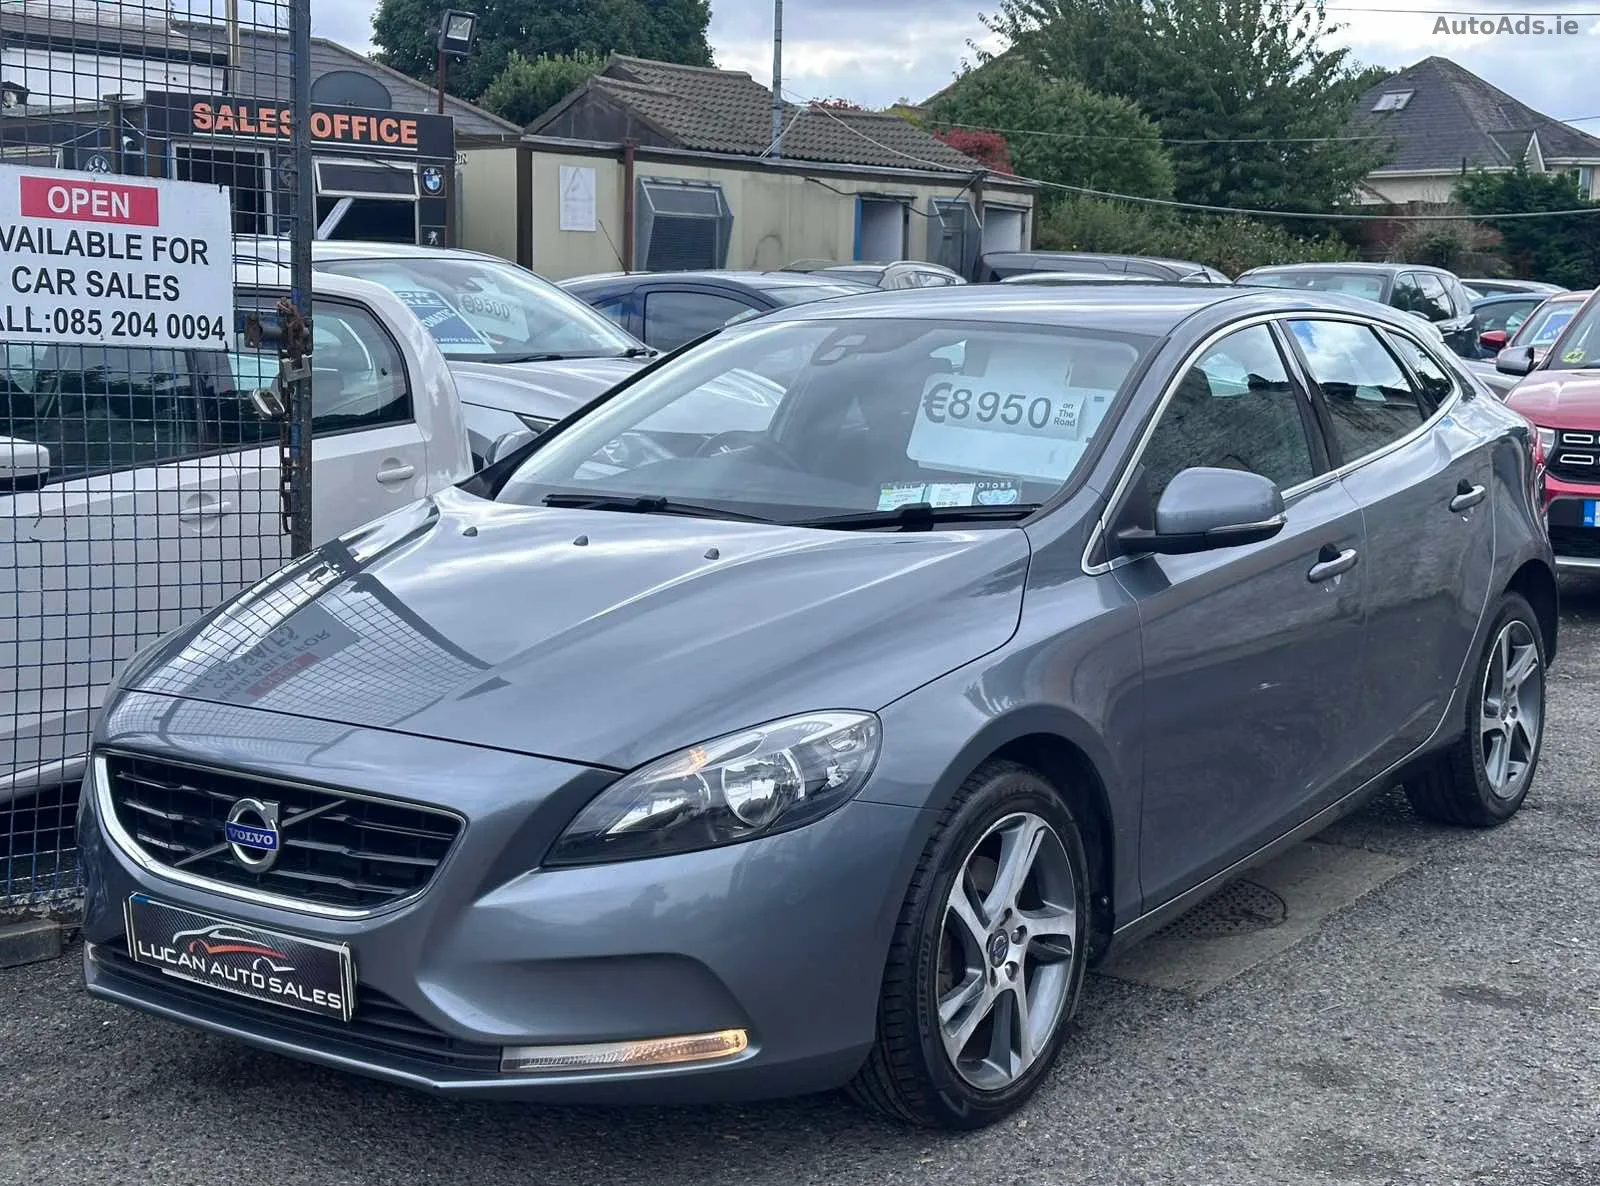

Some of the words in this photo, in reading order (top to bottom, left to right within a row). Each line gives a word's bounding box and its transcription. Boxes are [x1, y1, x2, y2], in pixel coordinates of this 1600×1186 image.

[310, 111, 418, 144] OFFICE
[47, 185, 130, 218] OPEN
[0, 224, 143, 261] VAILABLE
[152, 235, 209, 266] FOR
[11, 265, 77, 296] CAR
[86, 270, 180, 302] SALES
[0, 305, 102, 336] LL:085
[111, 310, 158, 338] 204
[166, 313, 225, 341] 0094
[922, 382, 1052, 429] €8950
[1058, 409, 1074, 418] The
[1062, 402, 1074, 410] on
[1053, 418, 1076, 427] Road
[228, 826, 274, 846] VOLVO
[137, 940, 206, 972] LUCAN
[210, 962, 265, 989] AUTO
[268, 976, 342, 1009] SALES
